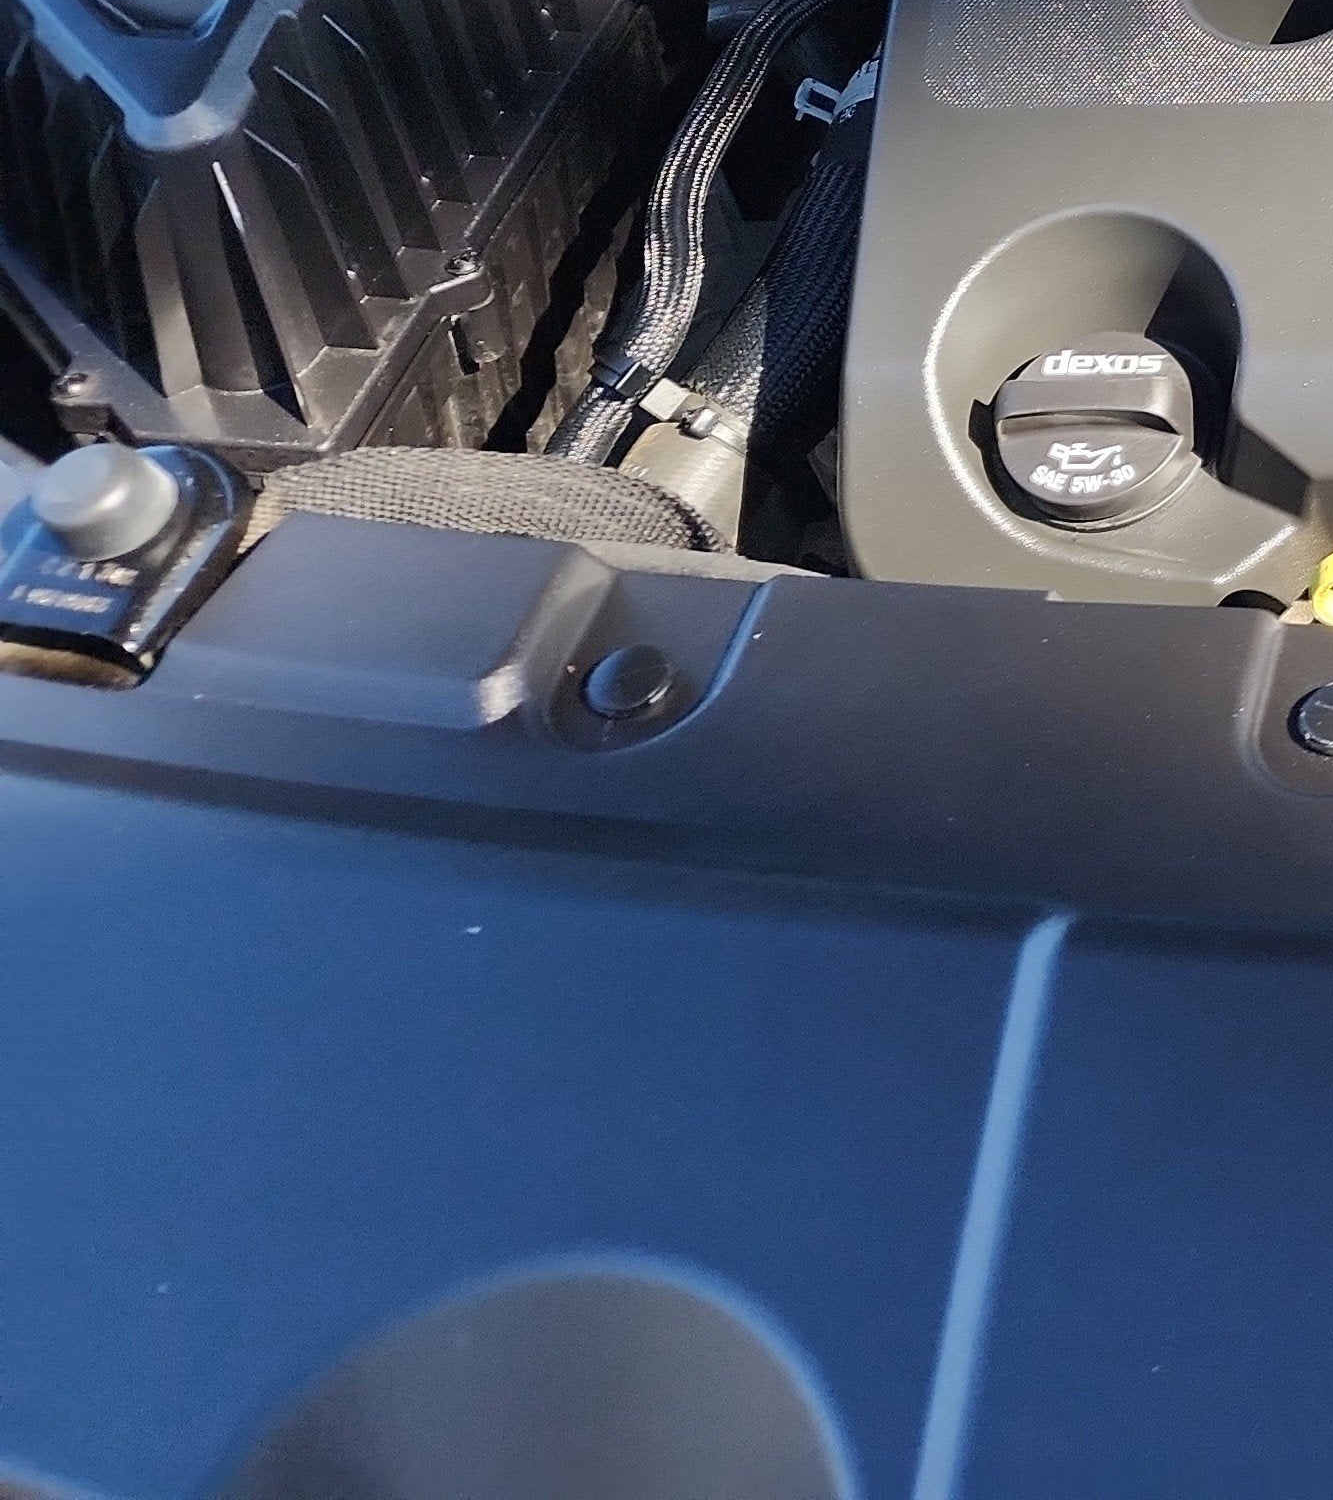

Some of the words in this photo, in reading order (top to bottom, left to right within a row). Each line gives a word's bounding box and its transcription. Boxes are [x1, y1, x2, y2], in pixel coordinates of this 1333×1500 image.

[1042, 349, 1168, 376] dexos
[1028, 465, 1069, 492] SAE
[1068, 463, 1136, 494] 5W-30
